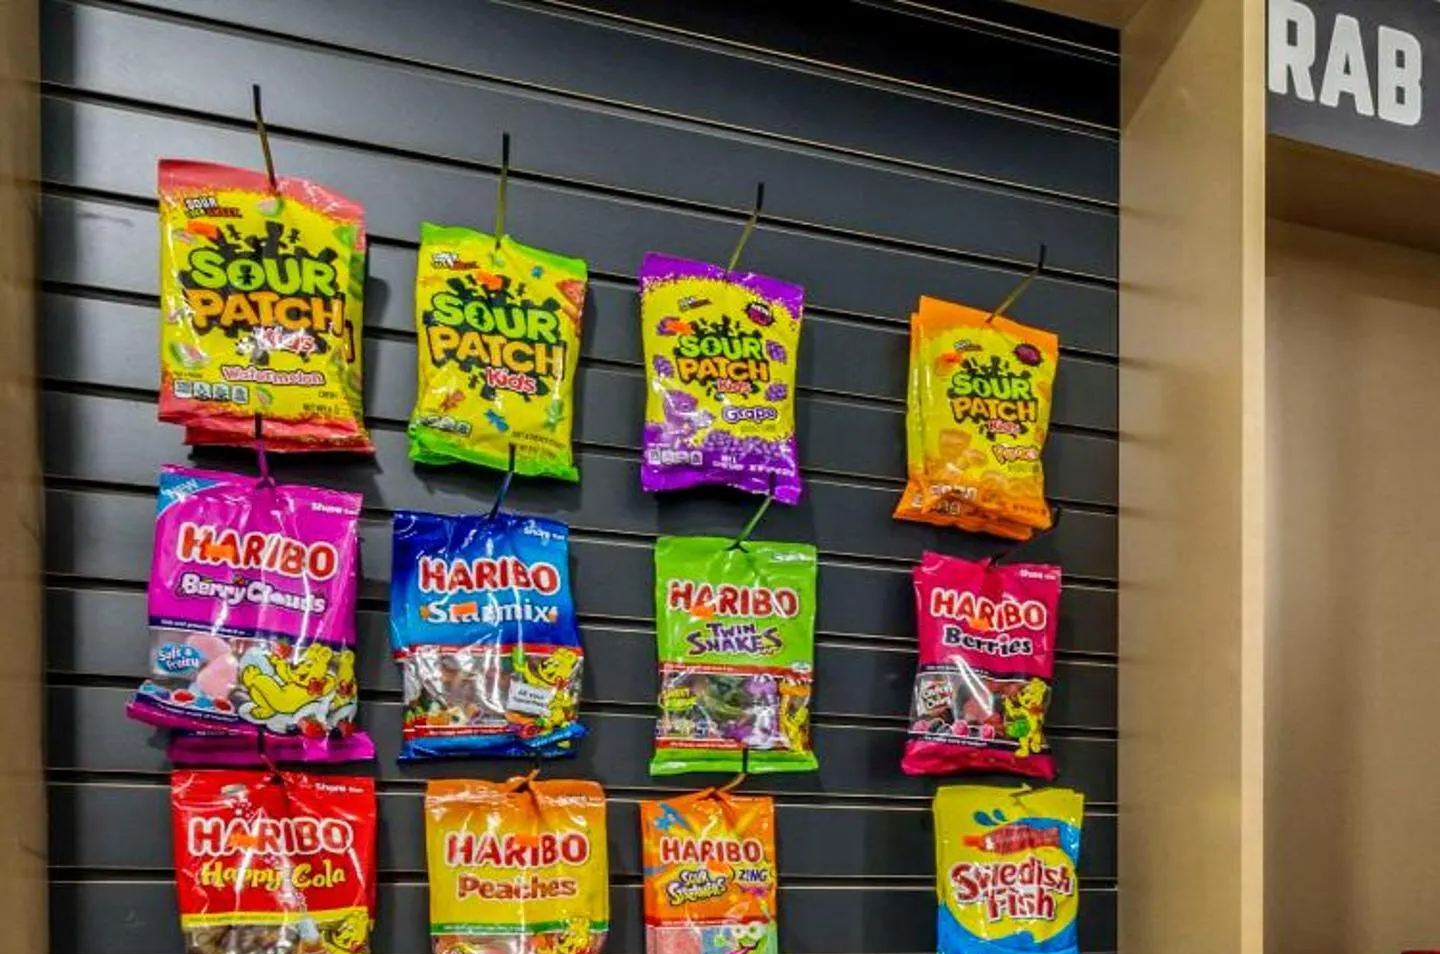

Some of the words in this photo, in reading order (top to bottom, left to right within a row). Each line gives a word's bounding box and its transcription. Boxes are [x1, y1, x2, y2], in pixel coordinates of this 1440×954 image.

[189, 249, 337, 298] SOUR
[185, 287, 346, 338] PATCH
[431, 292, 560, 344] SOUR
[427, 326, 566, 380] PATCH
[678, 335, 764, 361] SOUR
[221, 364, 326, 387] Watermelon
[485, 366, 538, 395] Kids
[675, 357, 770, 384] PATCH
[951, 373, 1033, 400] SOUR
[951, 396, 1038, 423] PATCH
[177, 522, 338, 581] HARIBO
[181, 572, 248, 607] Berry
[246, 581, 327, 614] Clouds
[418, 556, 561, 593] HARIBO
[667, 578, 800, 619] HARIBO
[930, 587, 1048, 632] HARIBO
[943, 624, 1034, 658] Berries
[188, 816, 355, 857] HARIBO
[445, 831, 591, 869] HARIBO
[660, 838, 765, 864] HARIBO
[200, 859, 284, 892] Happy
[291, 858, 347, 888] Cola
[457, 873, 578, 901] Peaches
[949, 857, 1073, 904] Swedish
[985, 886, 1057, 922] Fish
